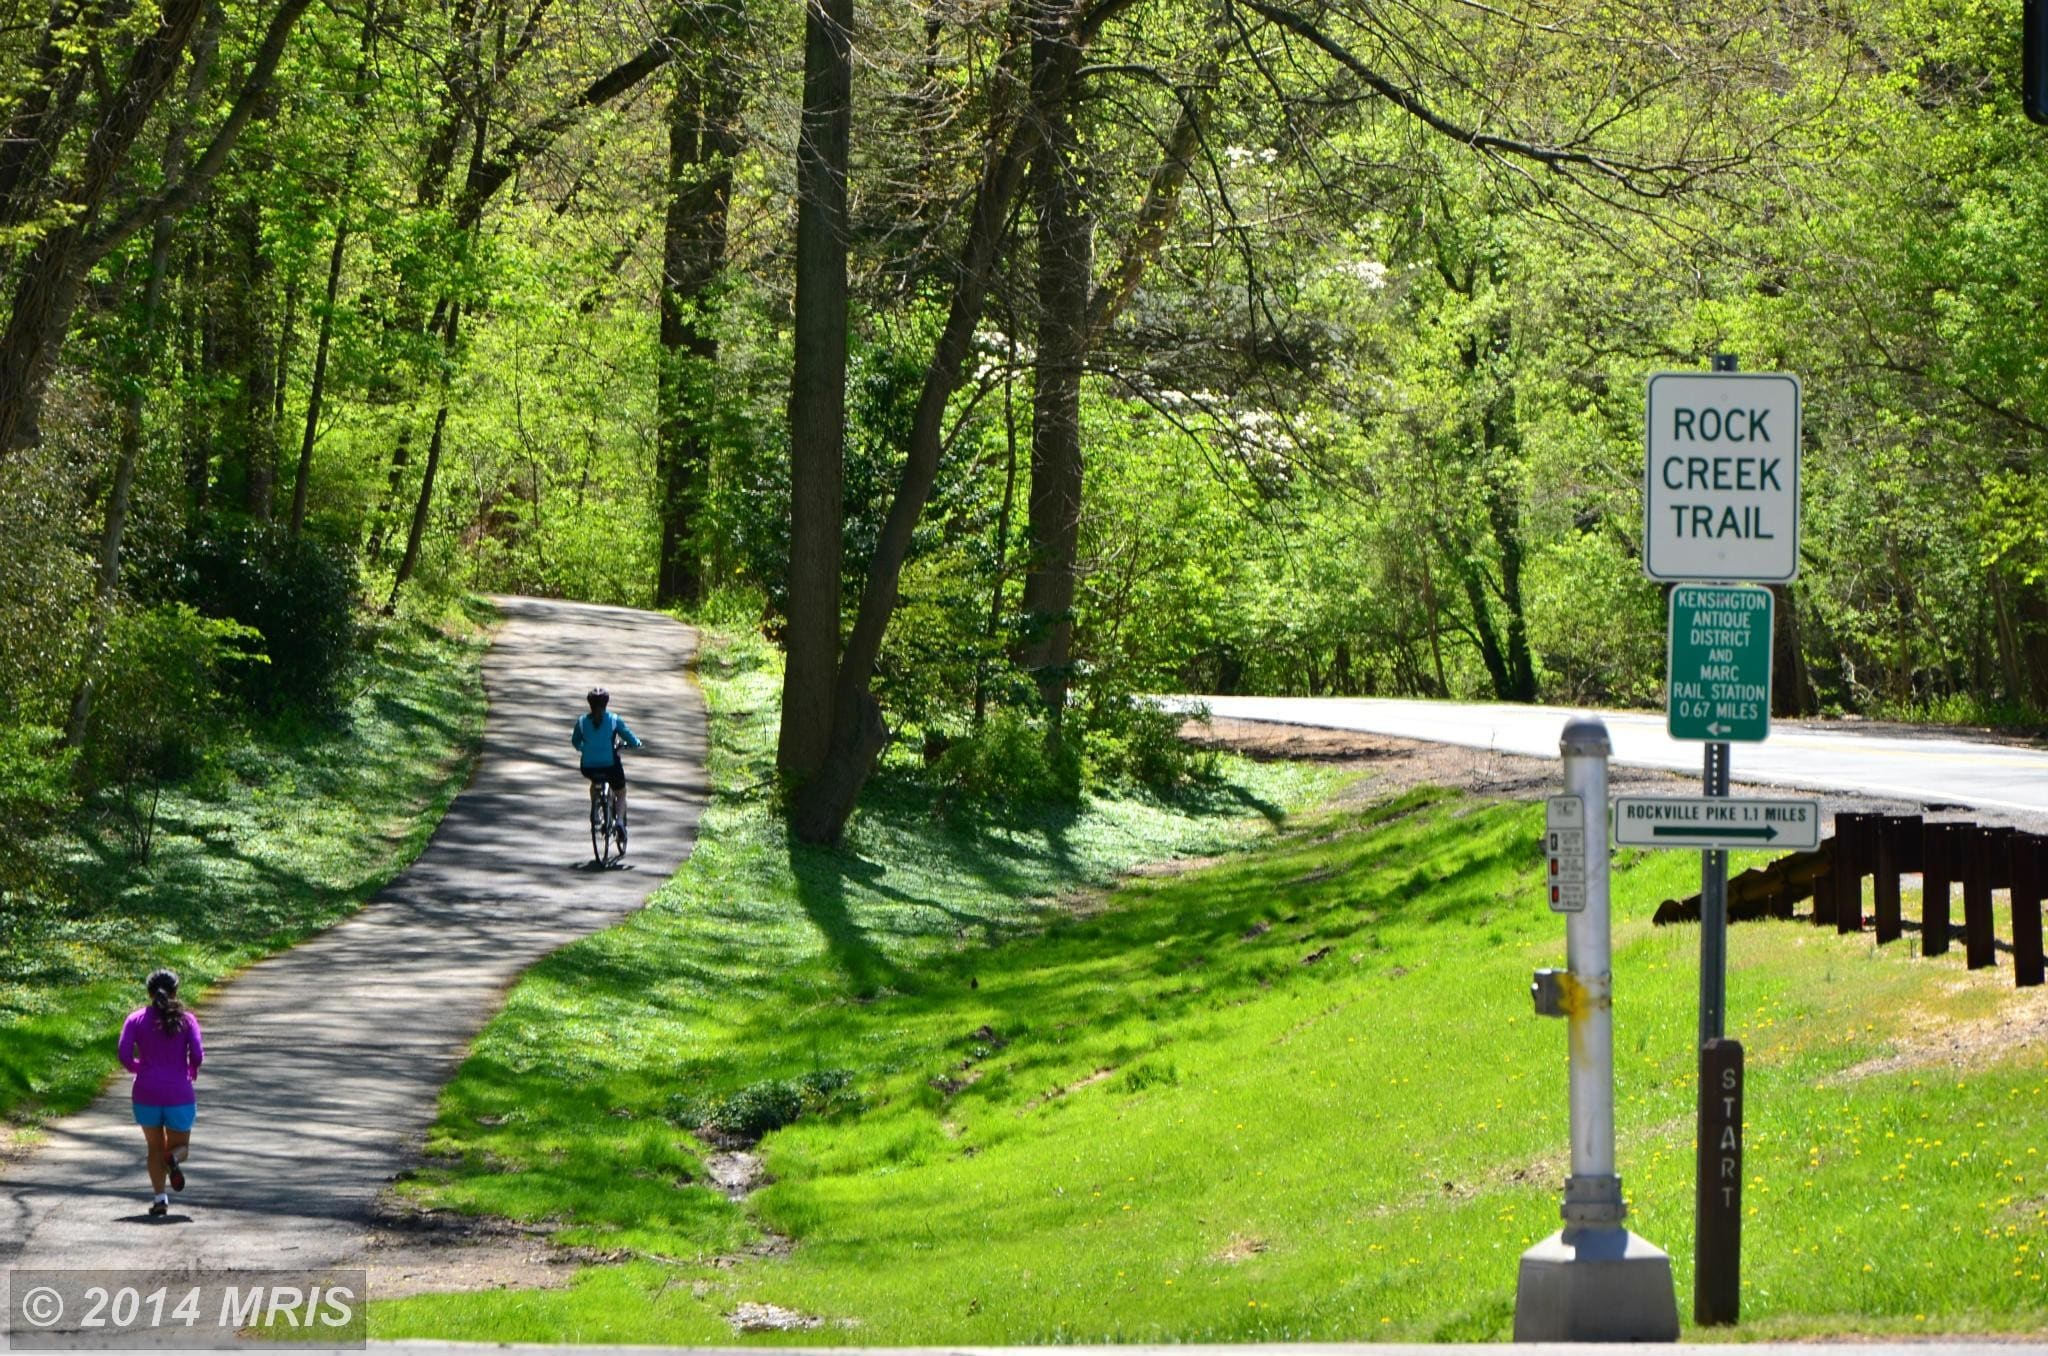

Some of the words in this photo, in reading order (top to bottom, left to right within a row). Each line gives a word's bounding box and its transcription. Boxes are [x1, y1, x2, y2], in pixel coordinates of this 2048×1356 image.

[1674, 407, 1771, 442] ROCK
[1663, 456, 1781, 491] CREEK
[1670, 504, 1774, 539] TRAIL
[1678, 591, 1766, 610] KENSINGTON
[1692, 610, 1751, 628] ANTIQUE
[1690, 629, 1751, 647] DISTRICT
[1708, 648, 1733, 662] AND
[1700, 664, 1739, 681] MARC
[1673, 682, 1705, 699] RAIL
[1711, 683, 1765, 701] STATION
[1679, 701, 1711, 718] 0.67
[1716, 702, 1758, 720] MILES
[1627, 804, 1699, 820] ROCKVILLE
[1706, 805, 1736, 821] PIKE
[1743, 806, 1758, 821] 1.1
[1765, 807, 1806, 822] MILES
[1720, 1068, 1736, 1208] START
